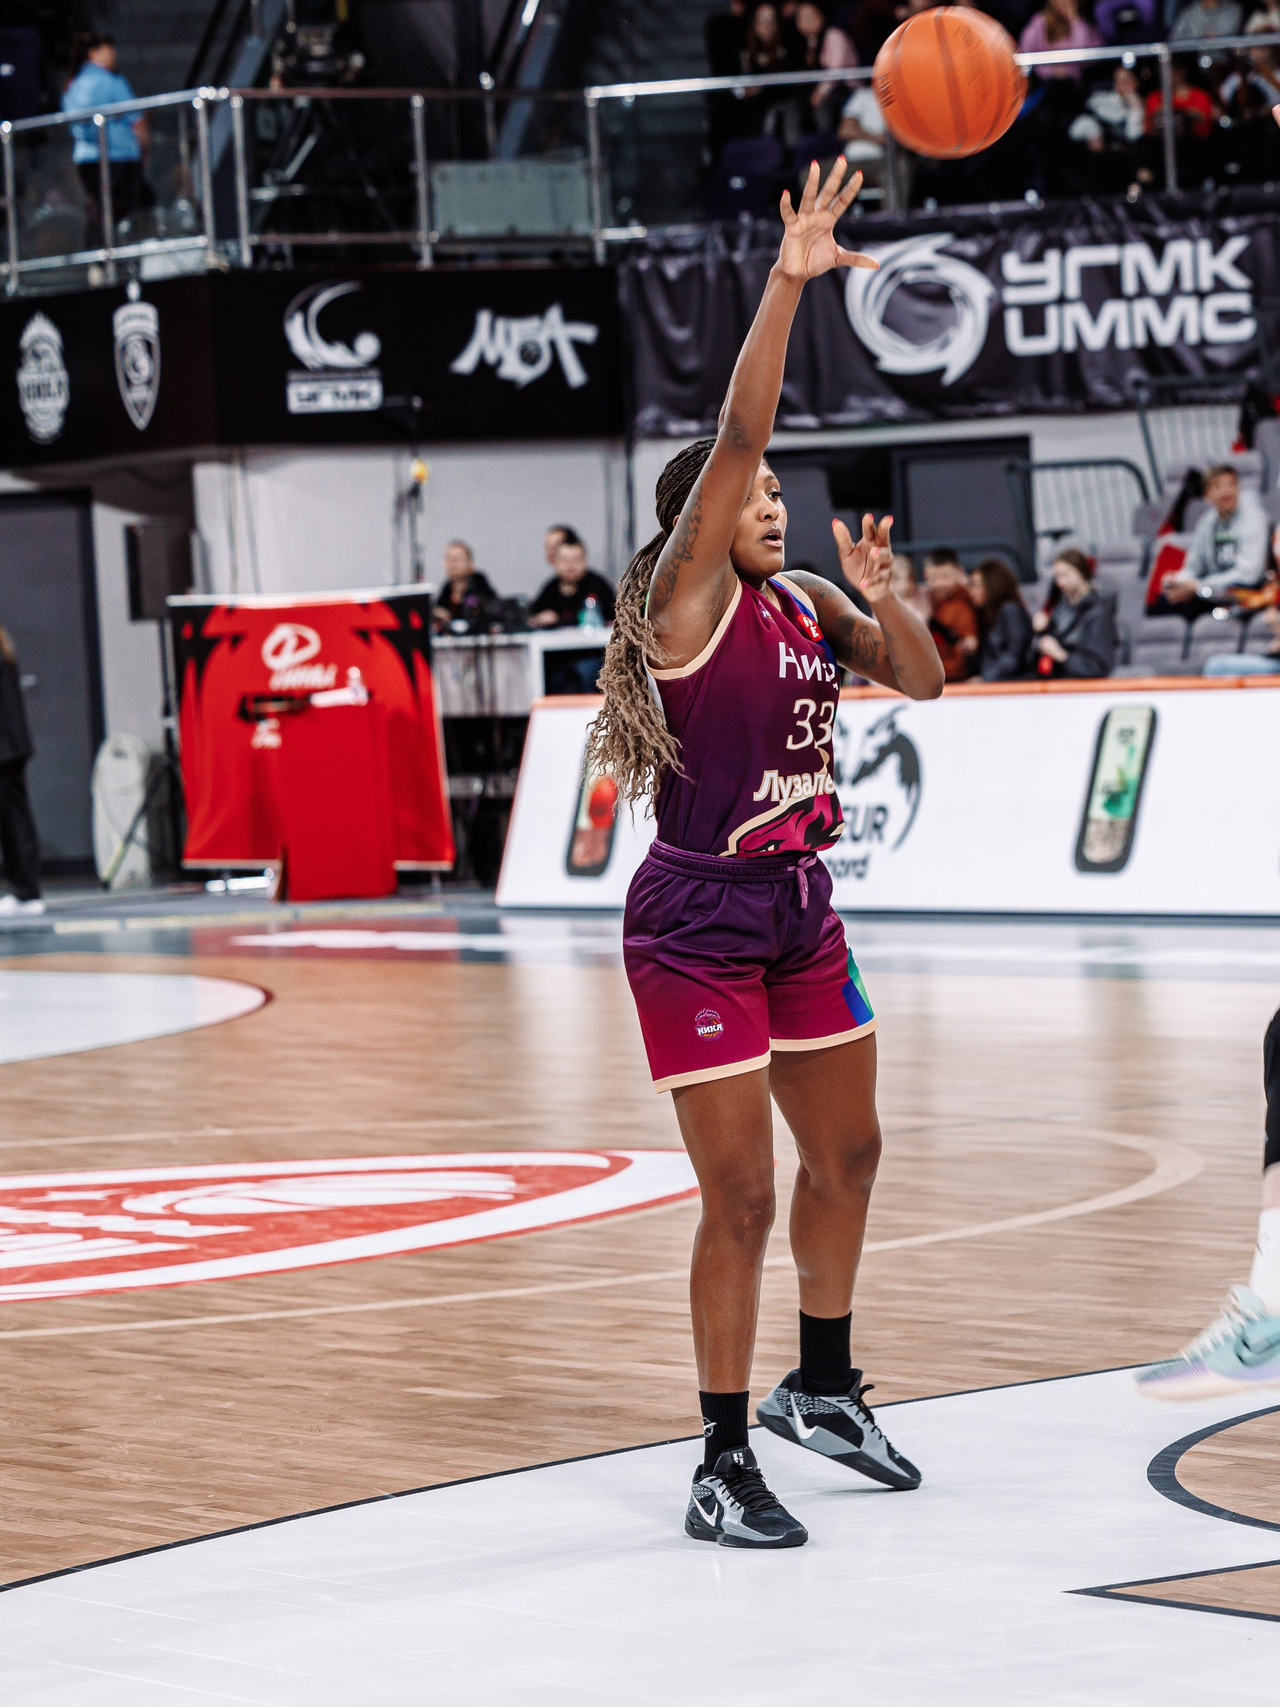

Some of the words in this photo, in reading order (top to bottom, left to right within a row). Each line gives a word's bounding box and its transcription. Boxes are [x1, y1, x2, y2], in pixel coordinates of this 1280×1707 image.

[1001, 234, 1253, 299] УГМК
[1002, 293, 1257, 357] UMMC
[786, 698, 836, 751] 33
